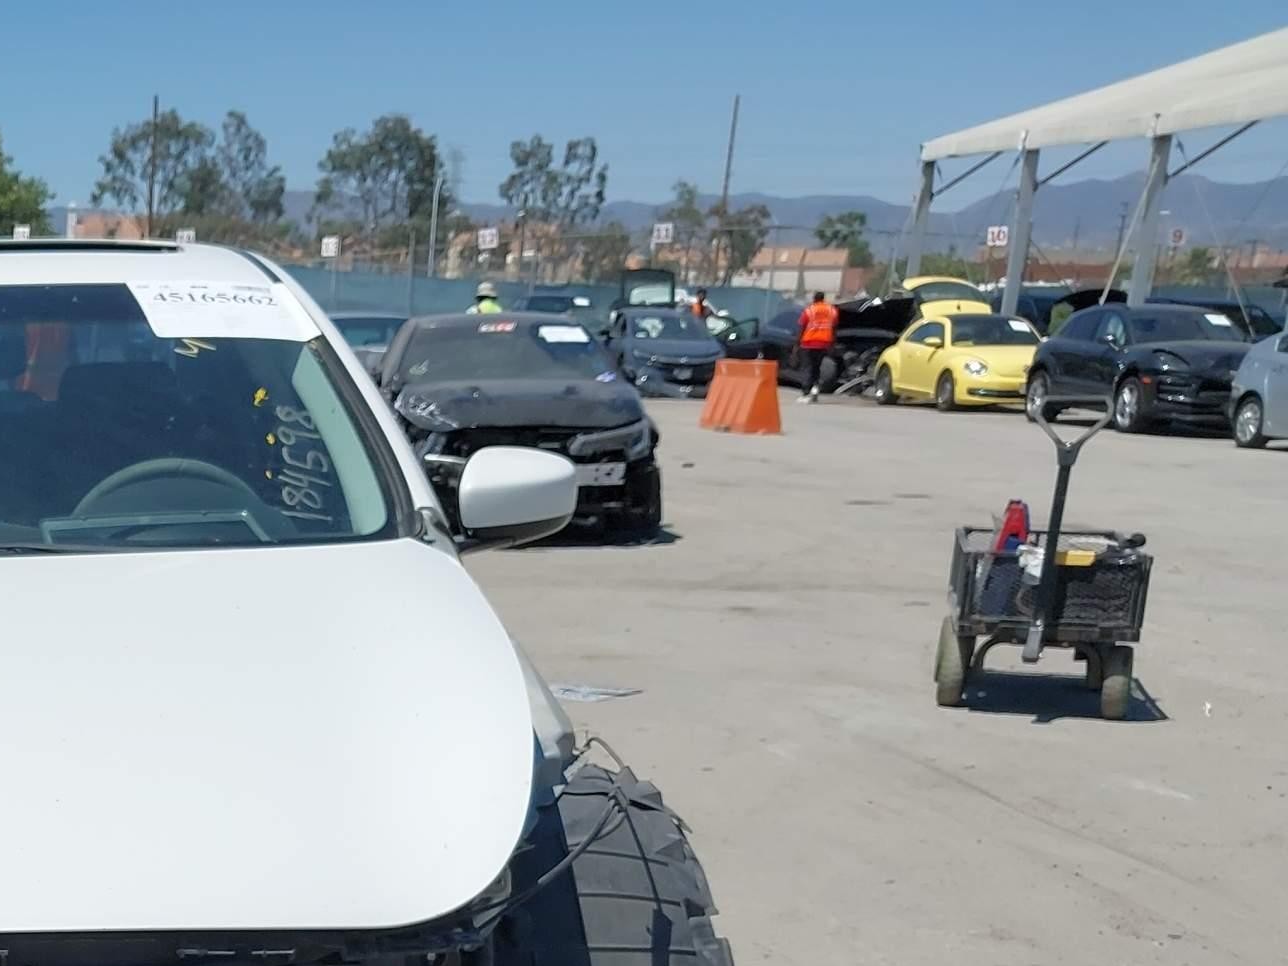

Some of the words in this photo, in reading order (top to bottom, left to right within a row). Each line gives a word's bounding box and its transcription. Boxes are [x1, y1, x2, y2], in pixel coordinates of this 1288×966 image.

[989, 229, 1006, 244] 10
[1173, 228, 1183, 241] 9
[276, 404, 333, 522] 184598
